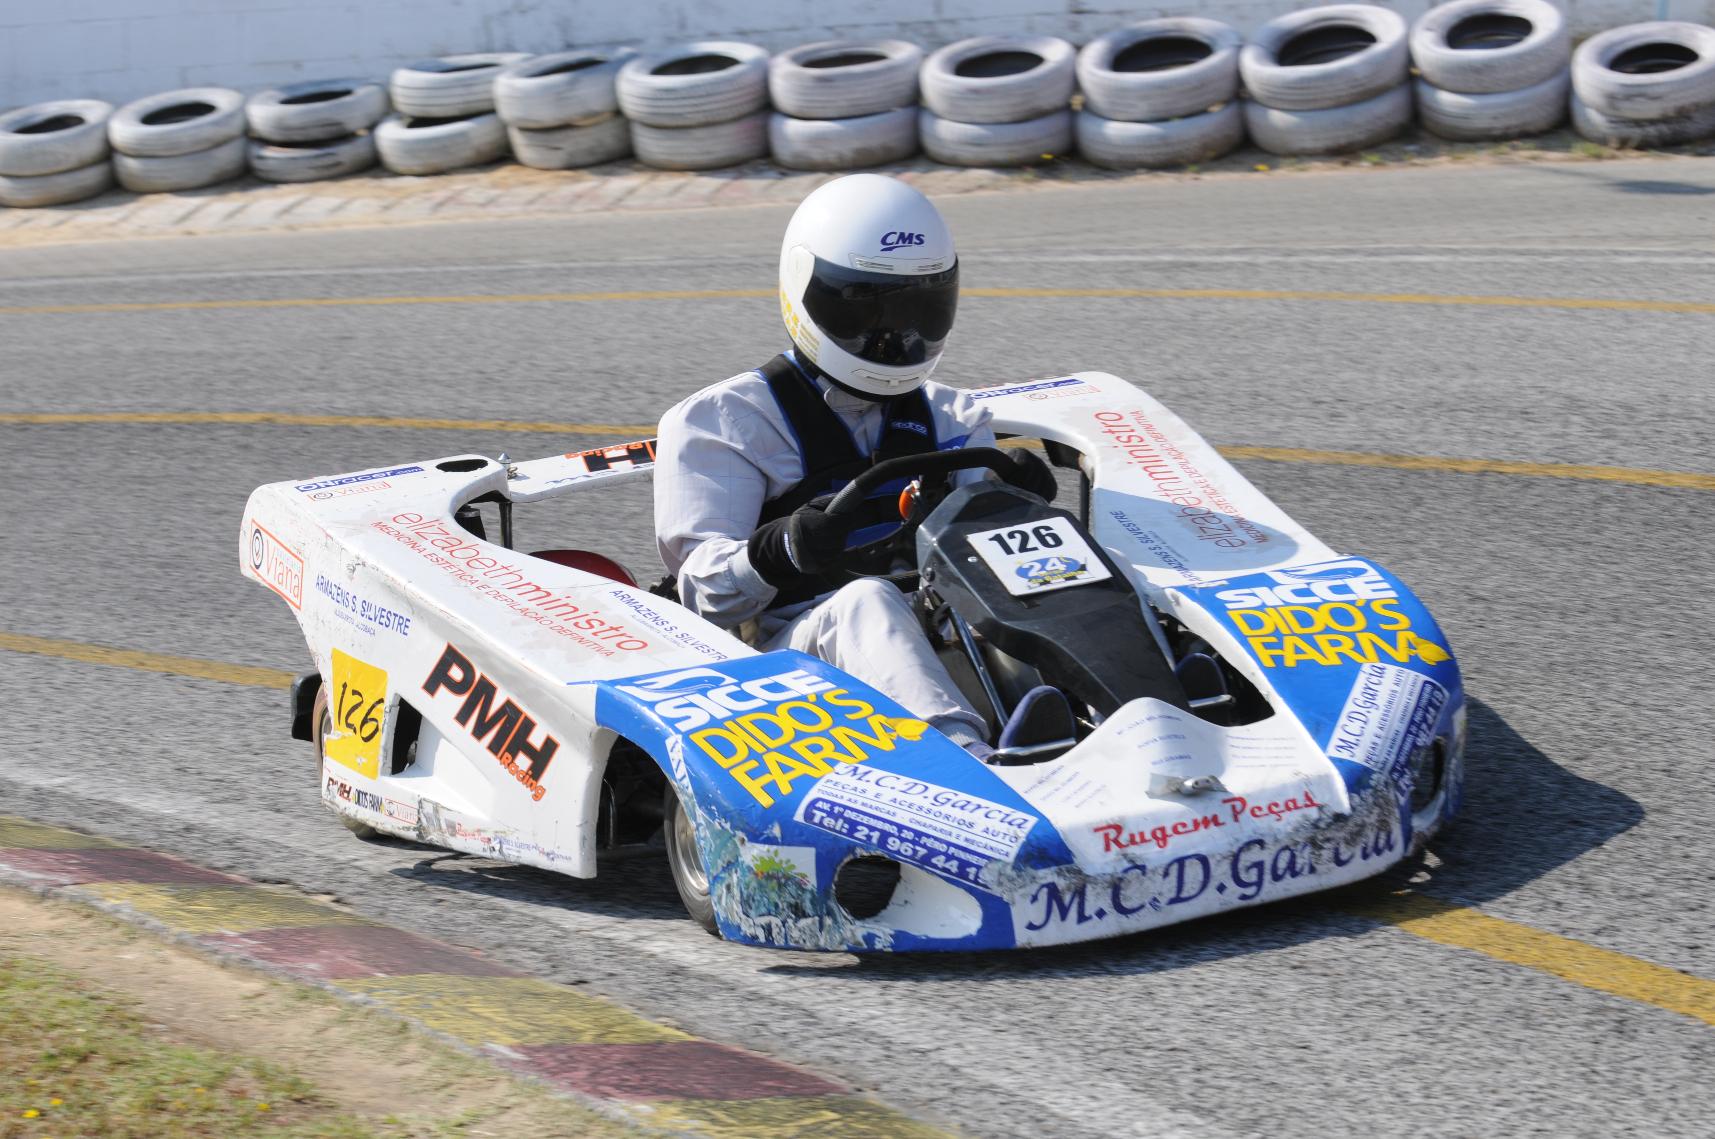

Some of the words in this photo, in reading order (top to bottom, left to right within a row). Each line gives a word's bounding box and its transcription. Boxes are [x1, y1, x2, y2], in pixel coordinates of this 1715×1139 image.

[880, 231, 925, 248] CMS
[1093, 411, 1247, 548] elizabethministro
[265, 541, 300, 600] Viana
[988, 525, 1064, 555] 126
[1022, 557, 1067, 577] 24
[371, 521, 427, 554] MEDICINA
[550, 624, 616, 657] DEFINITIVA
[392, 512, 648, 651] elizabethministro
[1215, 576, 1399, 609] SICCE
[360, 599, 411, 636] SILVESTRE
[1226, 598, 1412, 636] DIDO'S
[1247, 631, 1419, 668] FARM
[336, 682, 384, 743] 126
[421, 641, 561, 784] PMH
[654, 669, 838, 732] SICCE
[688, 688, 875, 770] DIDO'S
[500, 751, 546, 801] Racing
[728, 713, 896, 809] FARM
[811, 808, 850, 833] Tel:
[853, 825, 881, 845] 21
[886, 836, 928, 860] 967
[930, 854, 960, 874] 44
[1094, 812, 1226, 853] Rugem
[1221, 790, 1326, 823] Peças
